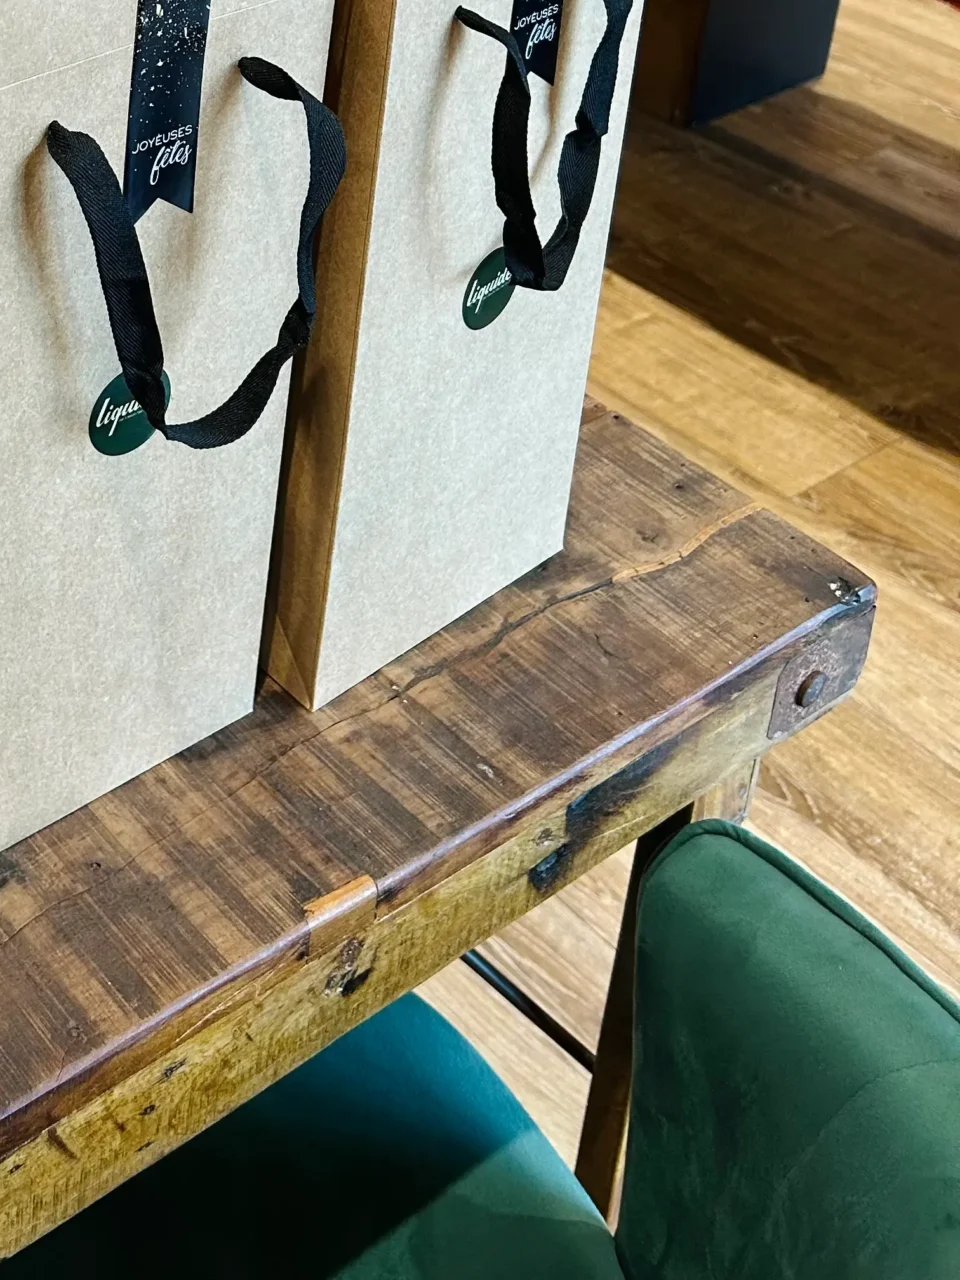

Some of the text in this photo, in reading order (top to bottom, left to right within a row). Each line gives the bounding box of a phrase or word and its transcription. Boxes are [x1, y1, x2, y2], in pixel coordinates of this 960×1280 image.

[514, 4, 559, 30] JOYEUSES
[525, 18, 557, 59] fêtes
[131, 124, 193, 154] JOYEUSES
[149, 140, 192, 185] fêtes
[466, 266, 512, 314] liquide
